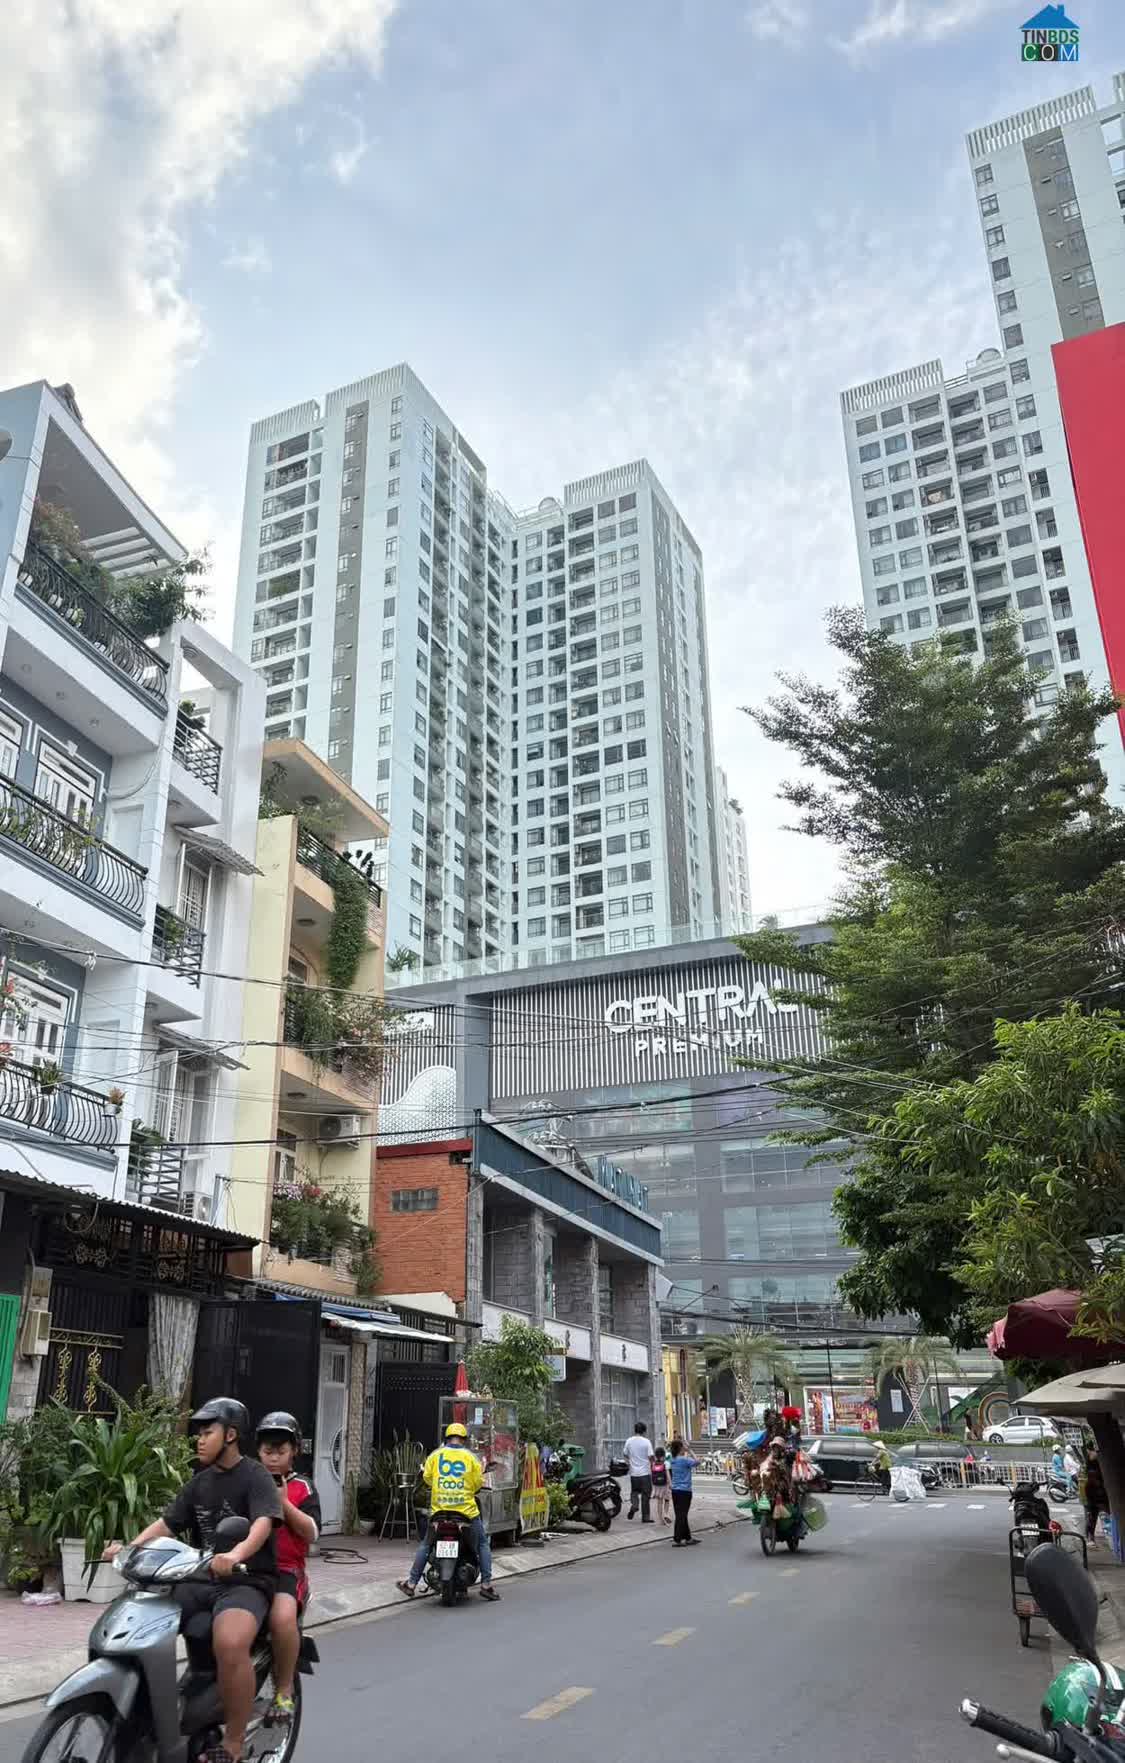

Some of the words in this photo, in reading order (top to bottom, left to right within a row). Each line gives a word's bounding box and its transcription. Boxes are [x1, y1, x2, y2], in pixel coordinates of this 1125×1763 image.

[605, 978, 798, 1033] CENTRAL
[439, 1453, 466, 1477] be
[438, 1477, 464, 1489] Food
